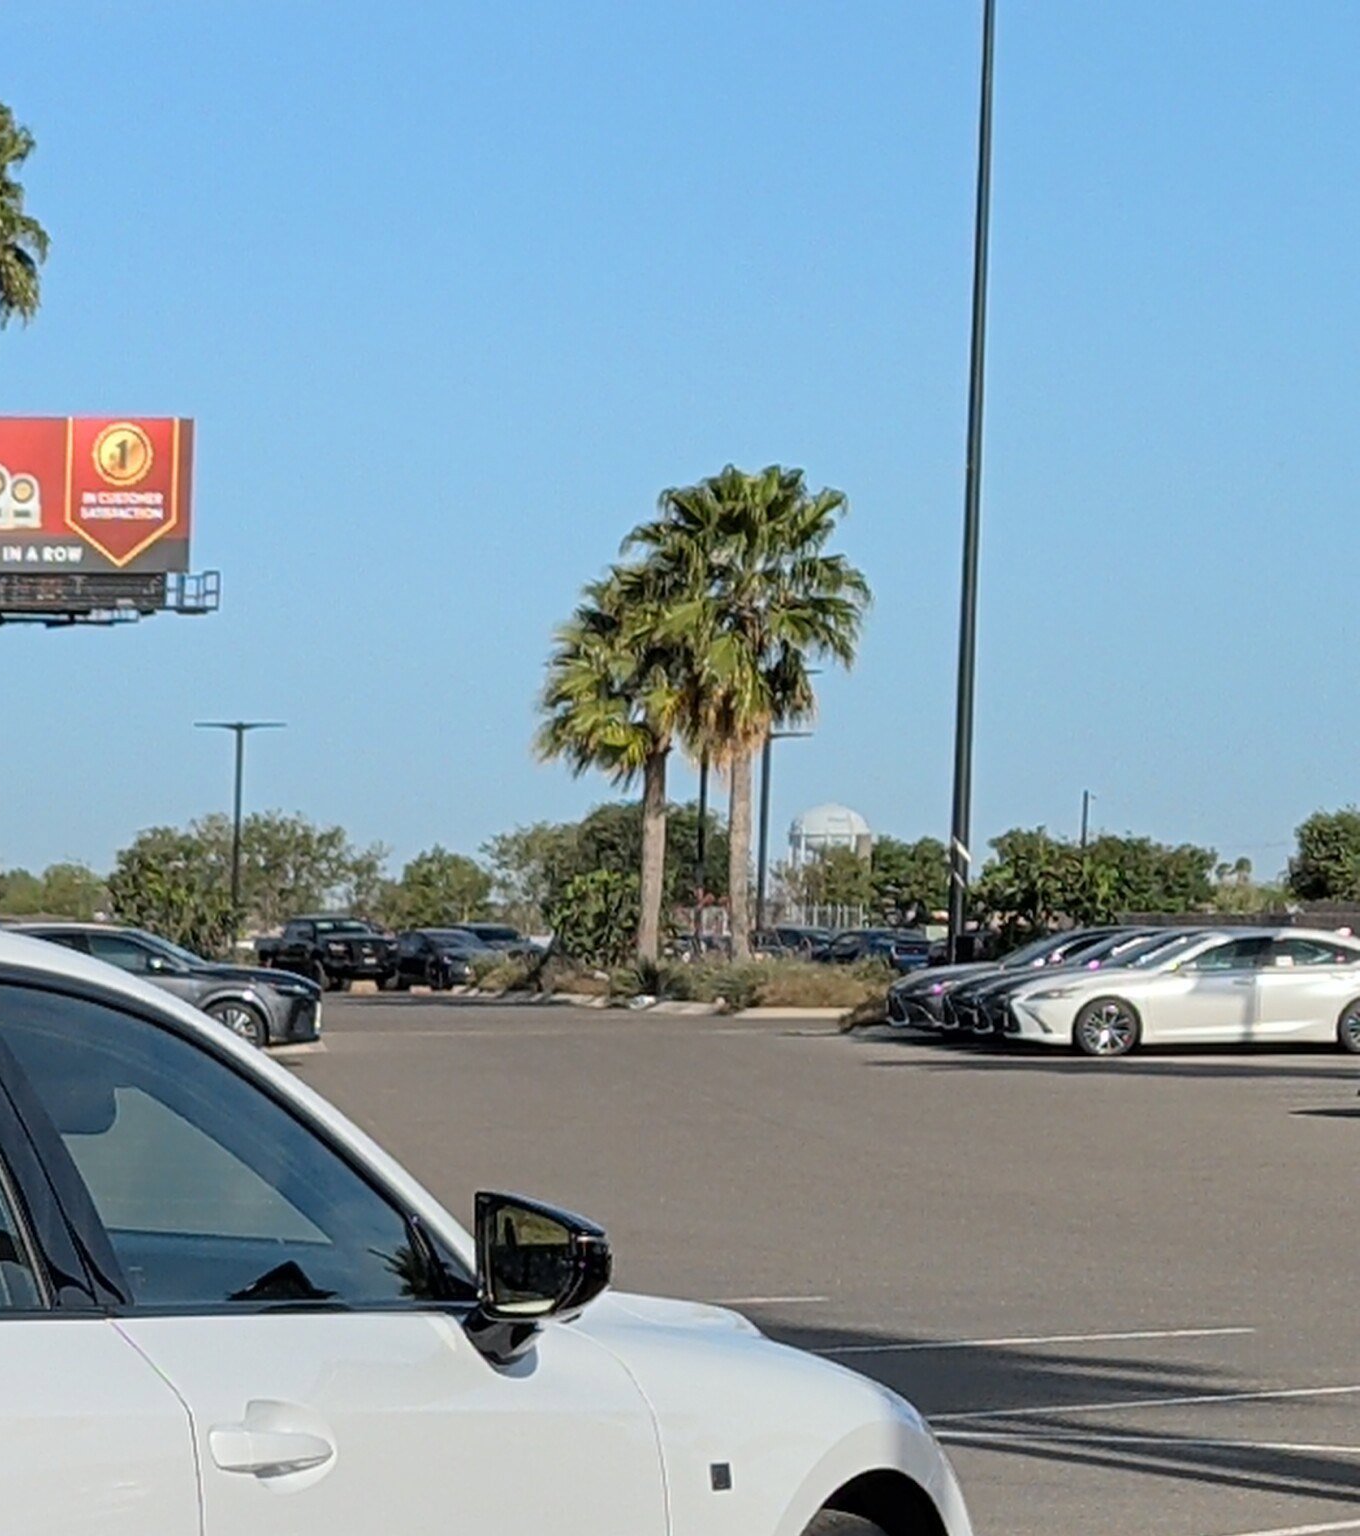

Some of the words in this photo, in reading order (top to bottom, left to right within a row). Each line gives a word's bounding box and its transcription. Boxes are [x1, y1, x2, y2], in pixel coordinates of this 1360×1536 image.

[115, 439, 129, 470] 1
[2, 546, 22, 561] IN
[24, 546, 40, 561] A
[42, 546, 83, 562] ROW
